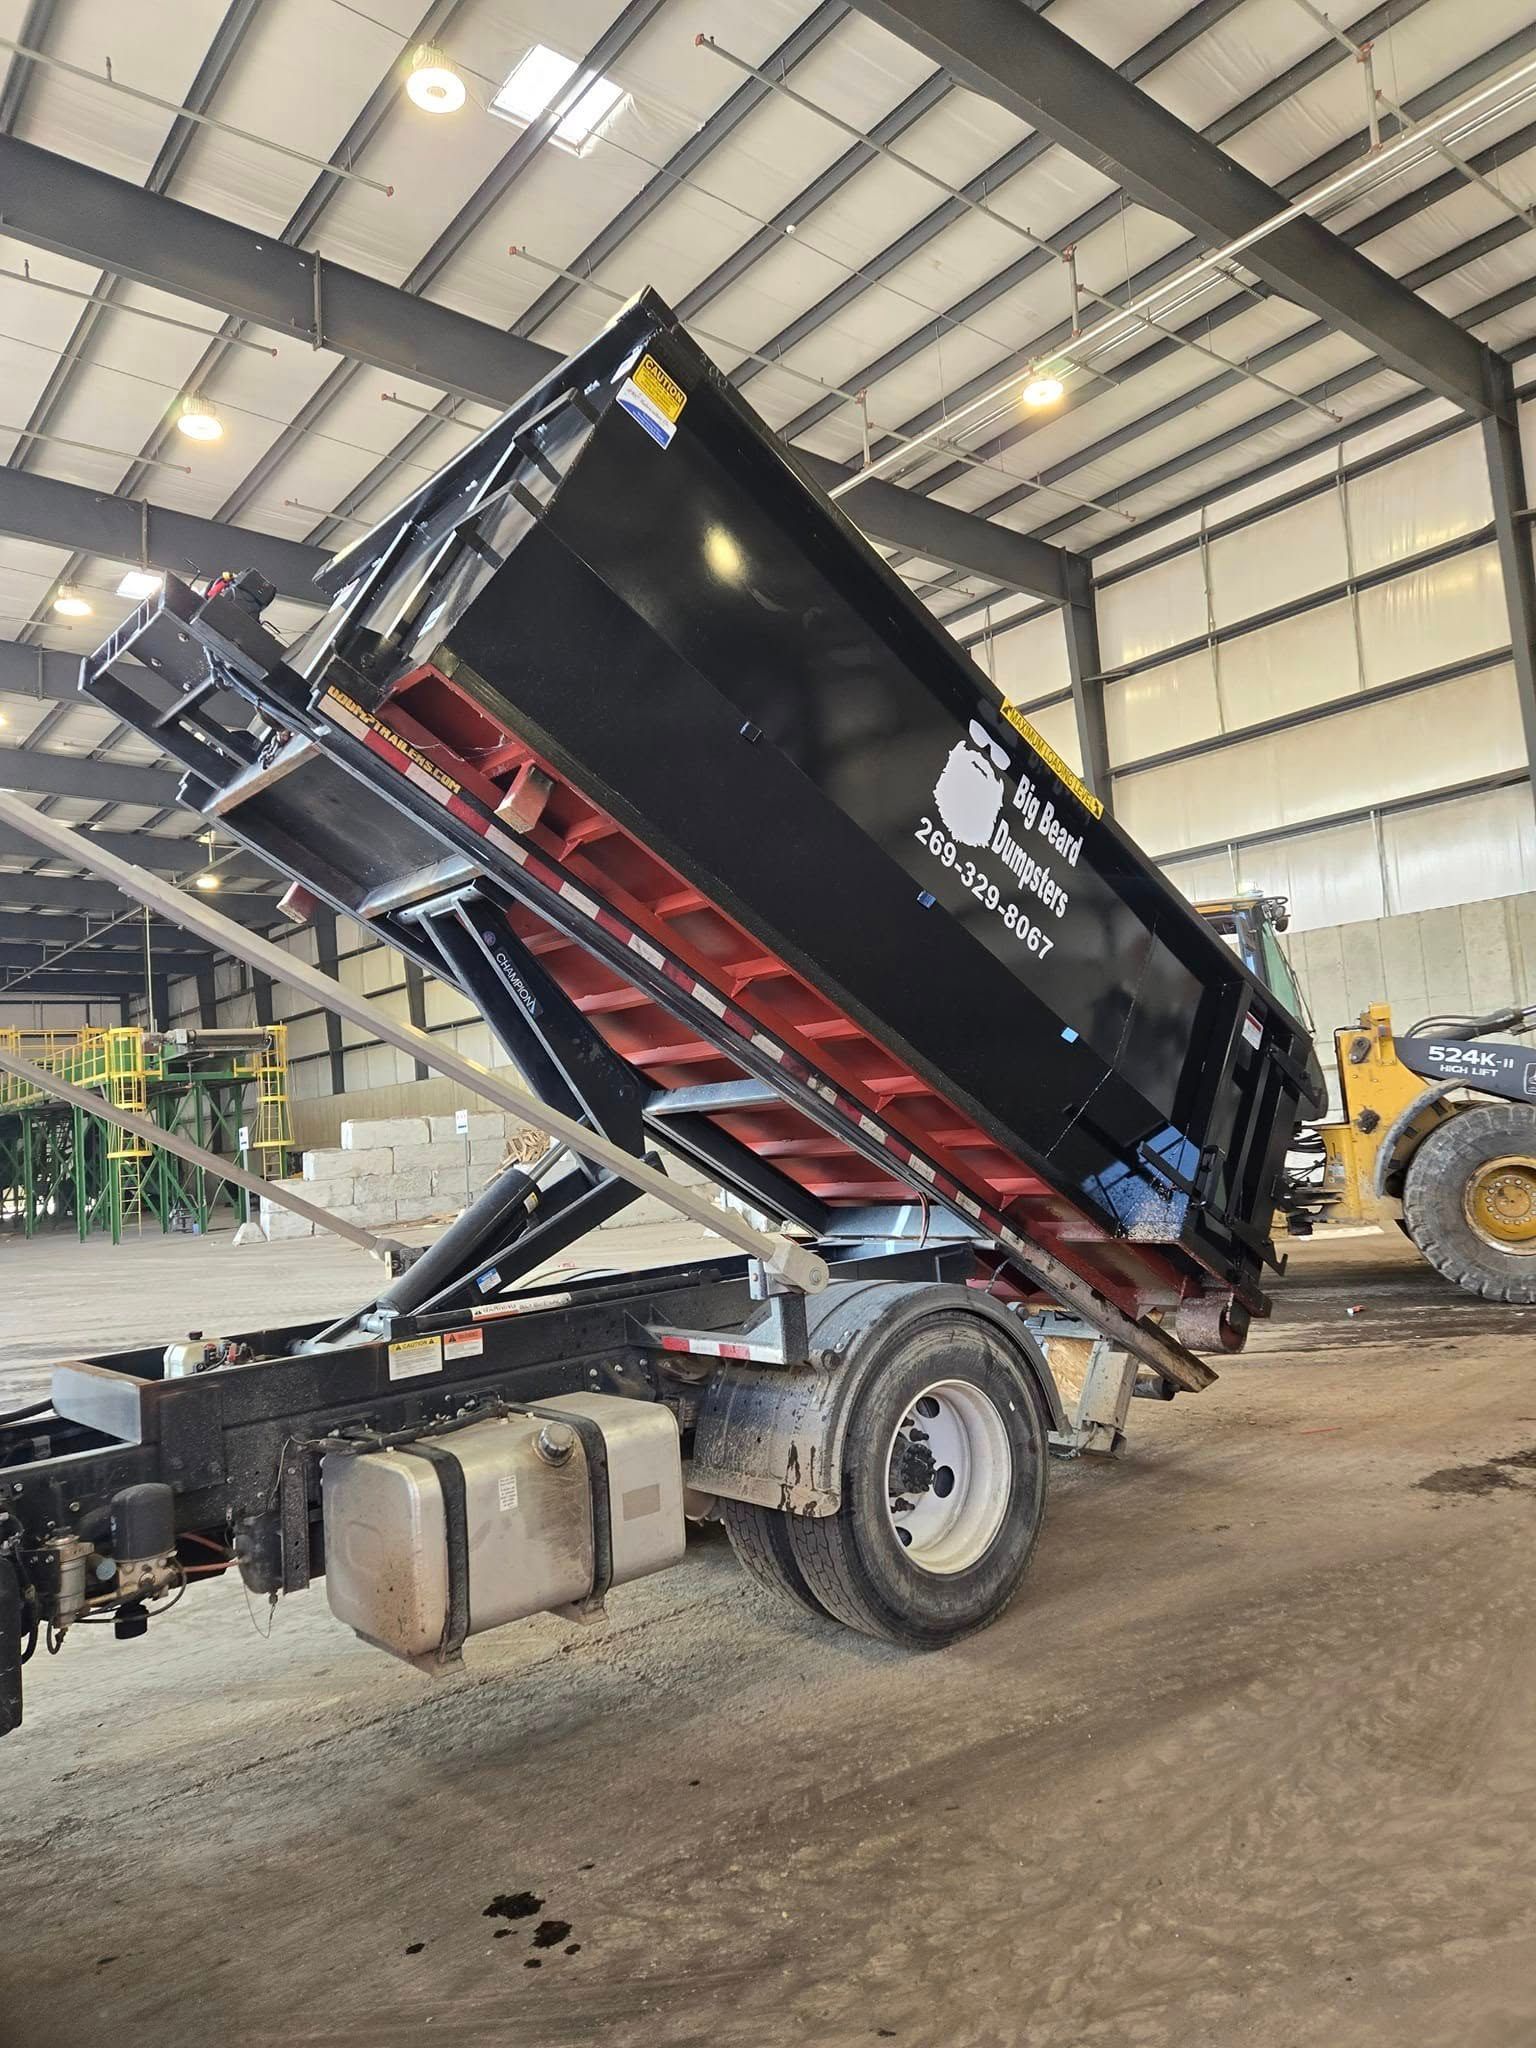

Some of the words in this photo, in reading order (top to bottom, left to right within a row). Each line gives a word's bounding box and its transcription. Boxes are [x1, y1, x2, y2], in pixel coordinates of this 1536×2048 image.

[645, 359, 684, 404] CAUTION
[1009, 708, 1044, 751] MAXIMUM
[1042, 743, 1074, 786] LOADING
[1073, 777, 1096, 809] LEVEL
[1012, 773, 1041, 831] Big
[1038, 800, 1084, 868] Beard
[914, 817, 1054, 960] 269-329-8067
[991, 818, 1069, 918] Dumpsters
[496, 953, 536, 1008] CHAMPION
[1440, 1064, 1468, 1075] HIGH
[1472, 1067, 1499, 1077] LIFT
[402, 1340, 428, 1349] CAUTION
